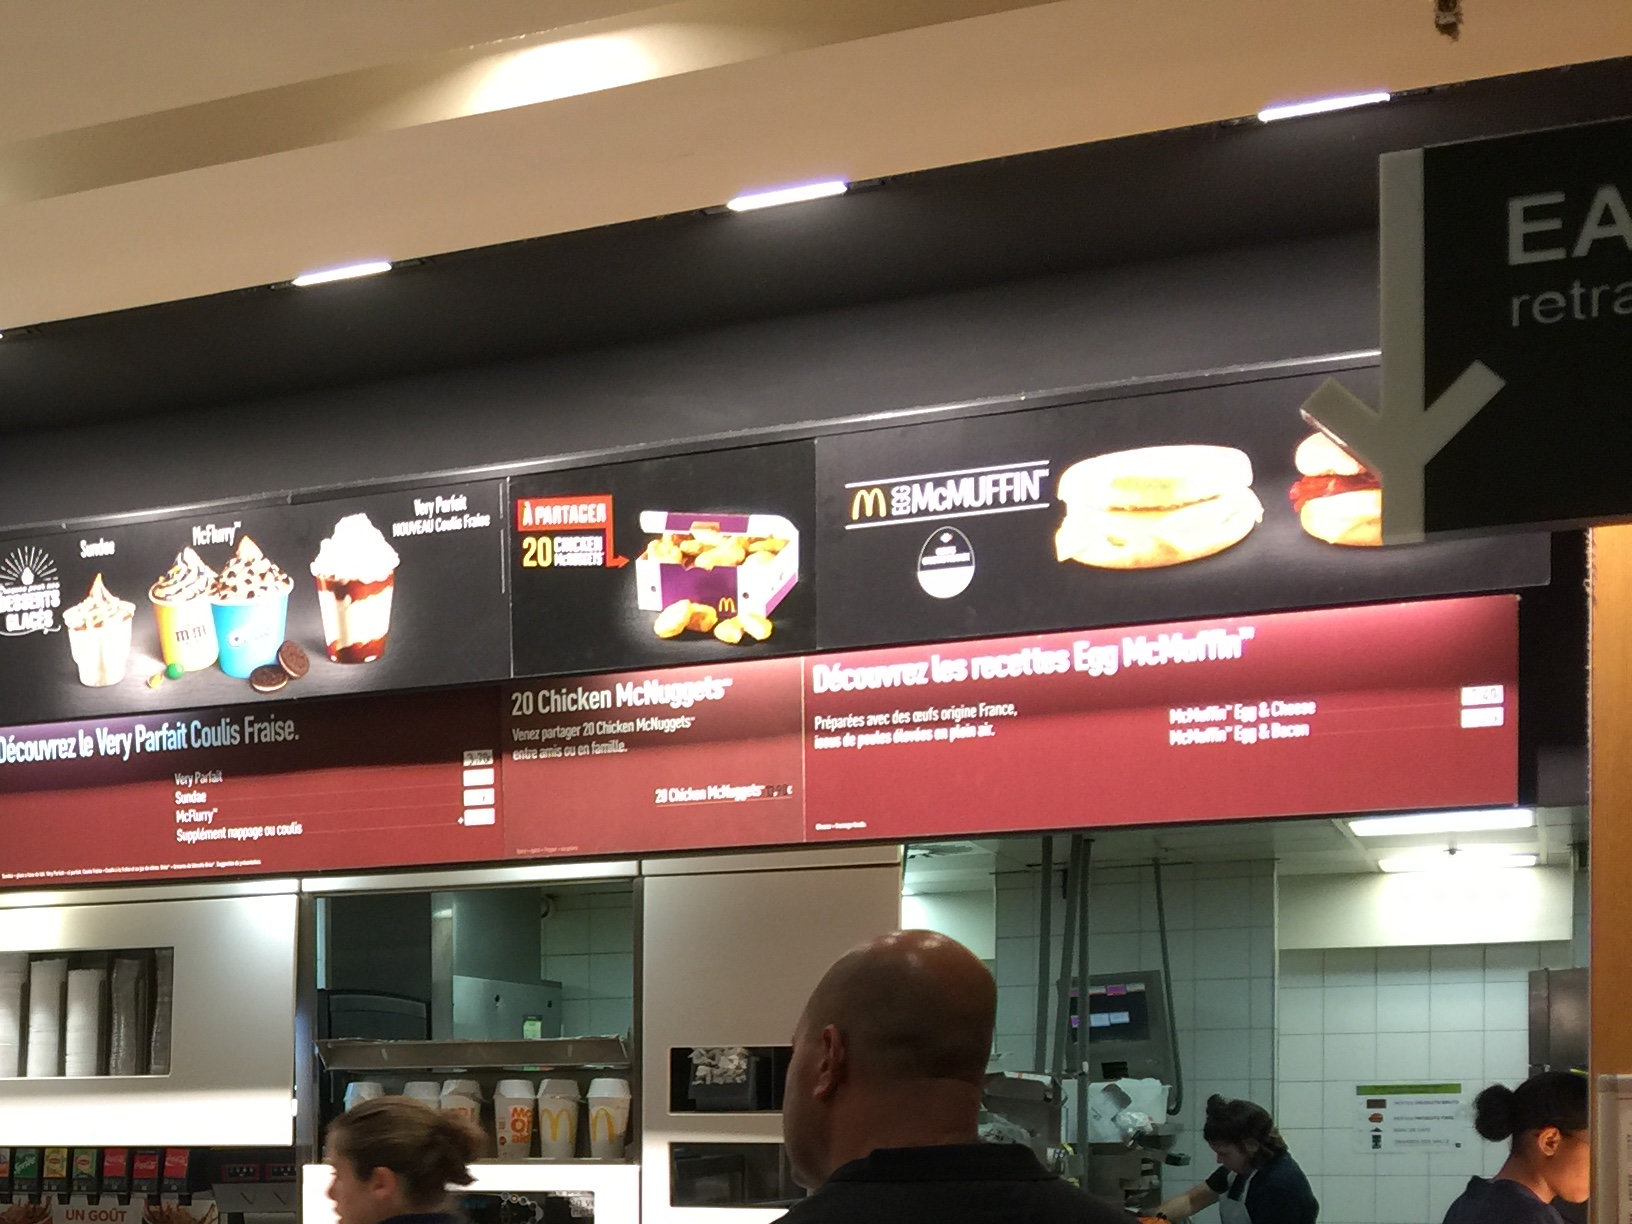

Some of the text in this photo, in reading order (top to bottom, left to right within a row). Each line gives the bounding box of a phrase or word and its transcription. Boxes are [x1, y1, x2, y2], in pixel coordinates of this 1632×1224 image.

[414, 494, 467, 519] Very Parfait
[534, 503, 607, 525] PARTAGER
[392, 513, 490, 537] NOUVEAU Coulis Fraise
[80, 537, 115, 558] Sundae
[522, 536, 552, 567] 20
[813, 662, 929, 694] Découvrez
[931, 654, 968, 683] les
[970, 647, 1070, 680] recettes
[1073, 640, 1119, 677] Egg
[512, 691, 534, 716] 20
[537, 683, 612, 714] Chicken
[814, 713, 865, 732] Préparées
[867, 714, 890, 727] avec
[892, 710, 910, 723] des
[941, 705, 977, 723] origine
[979, 702, 1018, 717] France,
[1233, 704, 1257, 722] Egg
[1258, 702, 1270, 718] &
[1271, 700, 1316, 717] Cheese
[79, 729, 94, 758] le
[95, 726, 132, 761] Very
[135, 721, 188, 753] Parfait
[190, 717, 240, 749] Coulis
[244, 714, 299, 743] Fraise.
[512, 727, 540, 743] Venez
[541, 725, 580, 742] partager
[582, 721, 595, 736] 20
[596, 719, 634, 735] Chicken
[842, 733, 855, 748] de
[934, 728, 948, 741] en
[949, 723, 976, 743] plein
[1233, 725, 1257, 744] Egg
[1258, 723, 1270, 740] &
[1271, 722, 1310, 738] Bacon
[512, 740, 628, 761] entre amis ou en famille.
[174, 770, 222, 787] Very Parfait
[175, 790, 206, 805] Sundae
[668, 787, 706, 802] Chicken
[176, 821, 303, 843] Supplément nappage ou coulis
[66, 1208, 127, 1222] UN GOÛT
